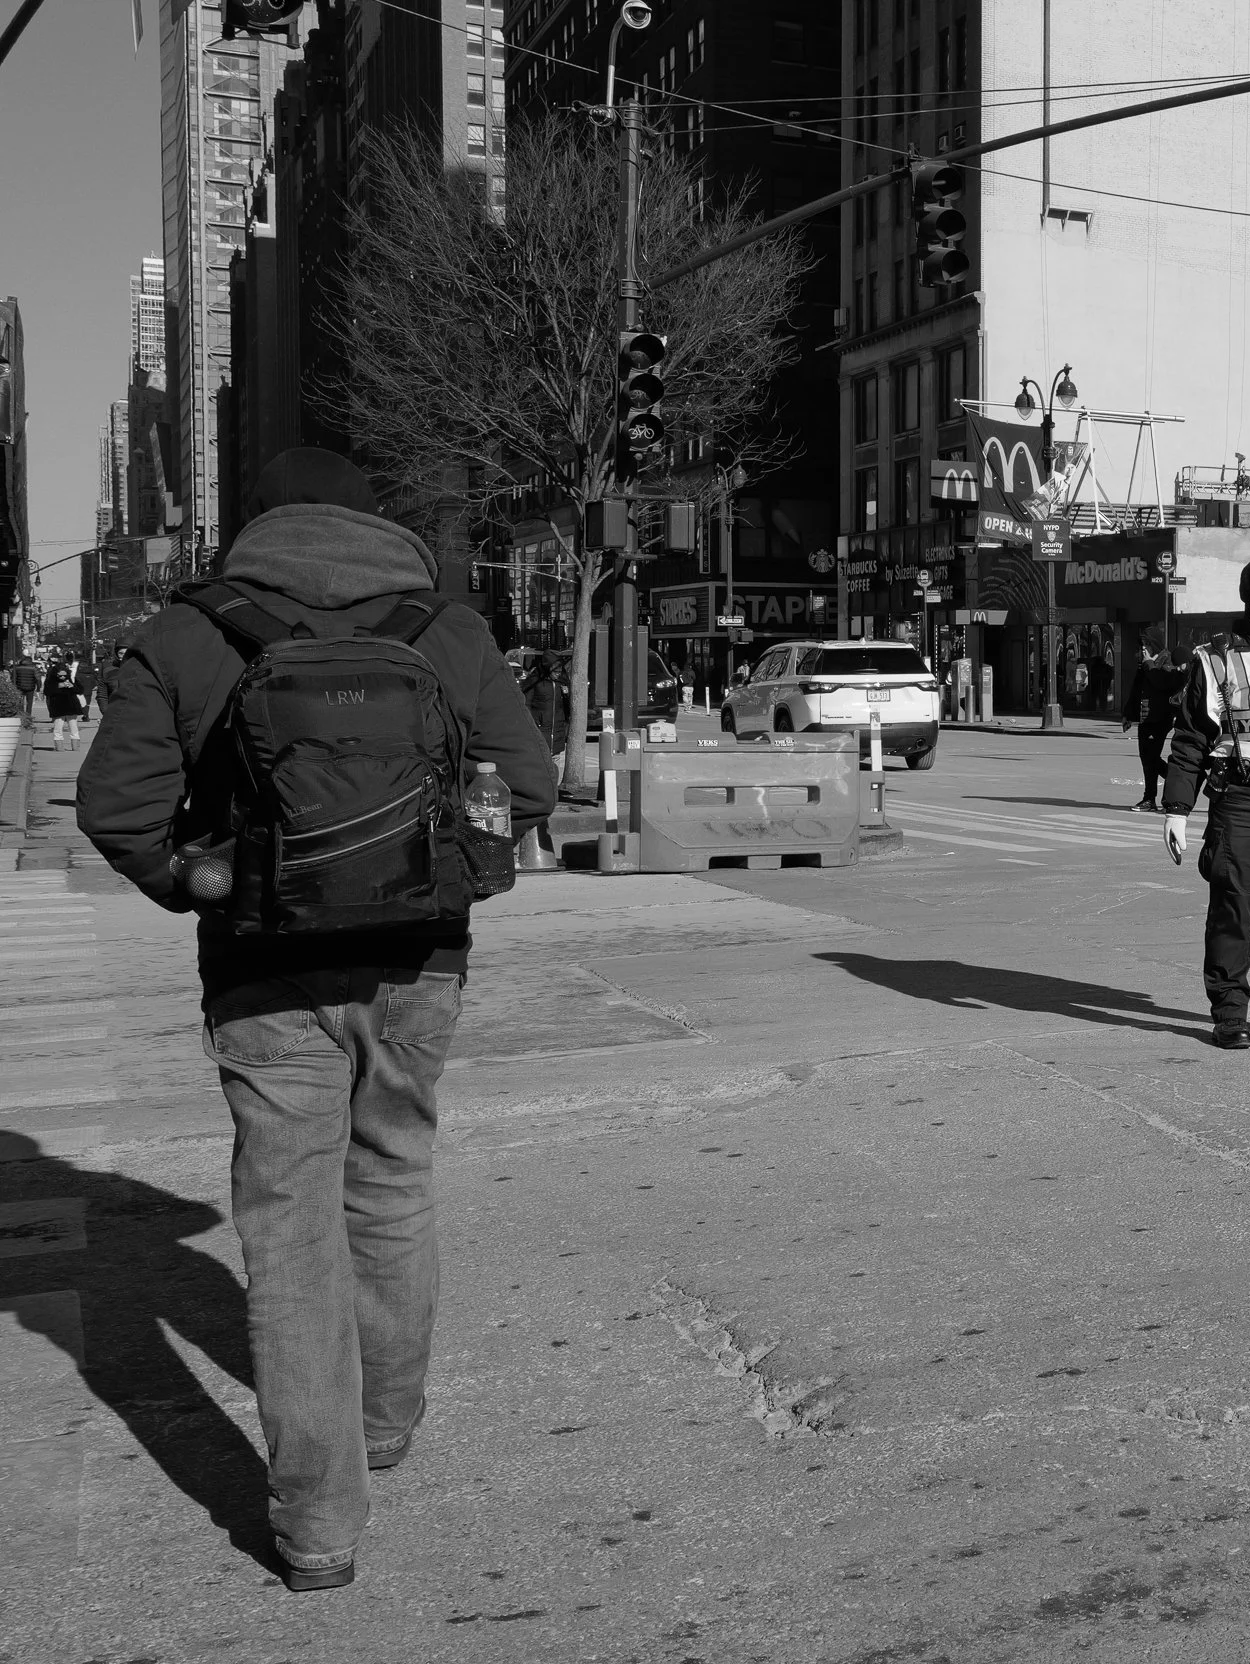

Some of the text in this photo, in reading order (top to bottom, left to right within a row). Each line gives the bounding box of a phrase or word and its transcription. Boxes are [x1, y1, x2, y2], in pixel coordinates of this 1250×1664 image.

[984, 516, 1014, 534] OPEN
[1040, 541, 1064, 549] Security
[838, 560, 878, 576] STARBUCKS
[885, 565, 894, 586] by
[1064, 556, 1149, 585] McDonald's
[846, 578, 871, 593] COFFEE
[660, 596, 697, 626] STAPLES
[326, 689, 365, 705] LRW
